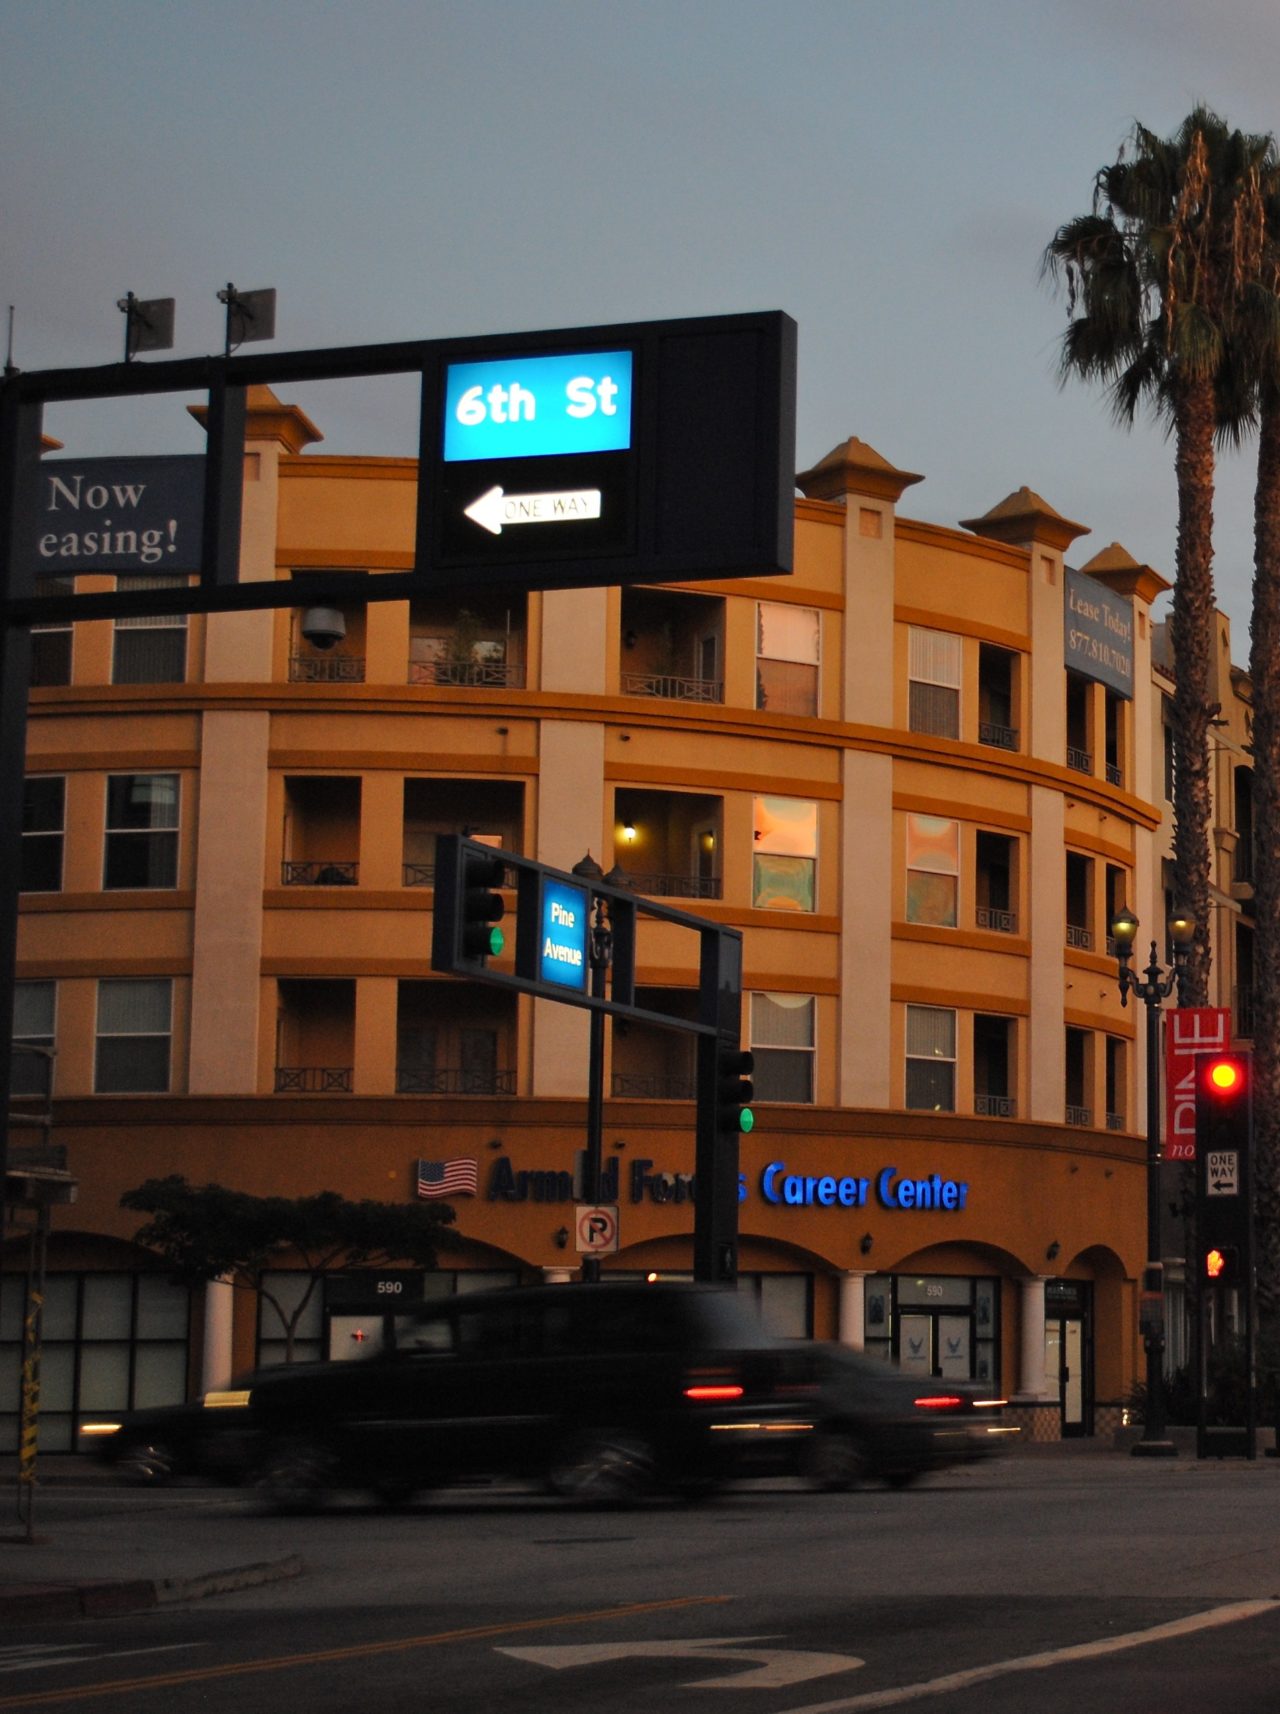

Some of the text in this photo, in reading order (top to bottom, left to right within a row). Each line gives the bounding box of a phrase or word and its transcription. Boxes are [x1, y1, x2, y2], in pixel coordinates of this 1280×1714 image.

[456, 375, 618, 426] 6th St
[47, 475, 147, 511] Now
[504, 496, 588, 520] ONE WAY
[38, 519, 177, 563] easing!
[1070, 587, 1099, 622] Lease
[551, 902, 575, 928] Pine
[544, 937, 582, 966] Avenue
[1210, 1155, 1234, 1166] ONE
[1210, 1167, 1234, 1178] WAY
[486, 1156, 969, 1210] Armd Fors Career Center
[377, 1281, 403, 1294] 590
[927, 1284, 943, 1297] 590
